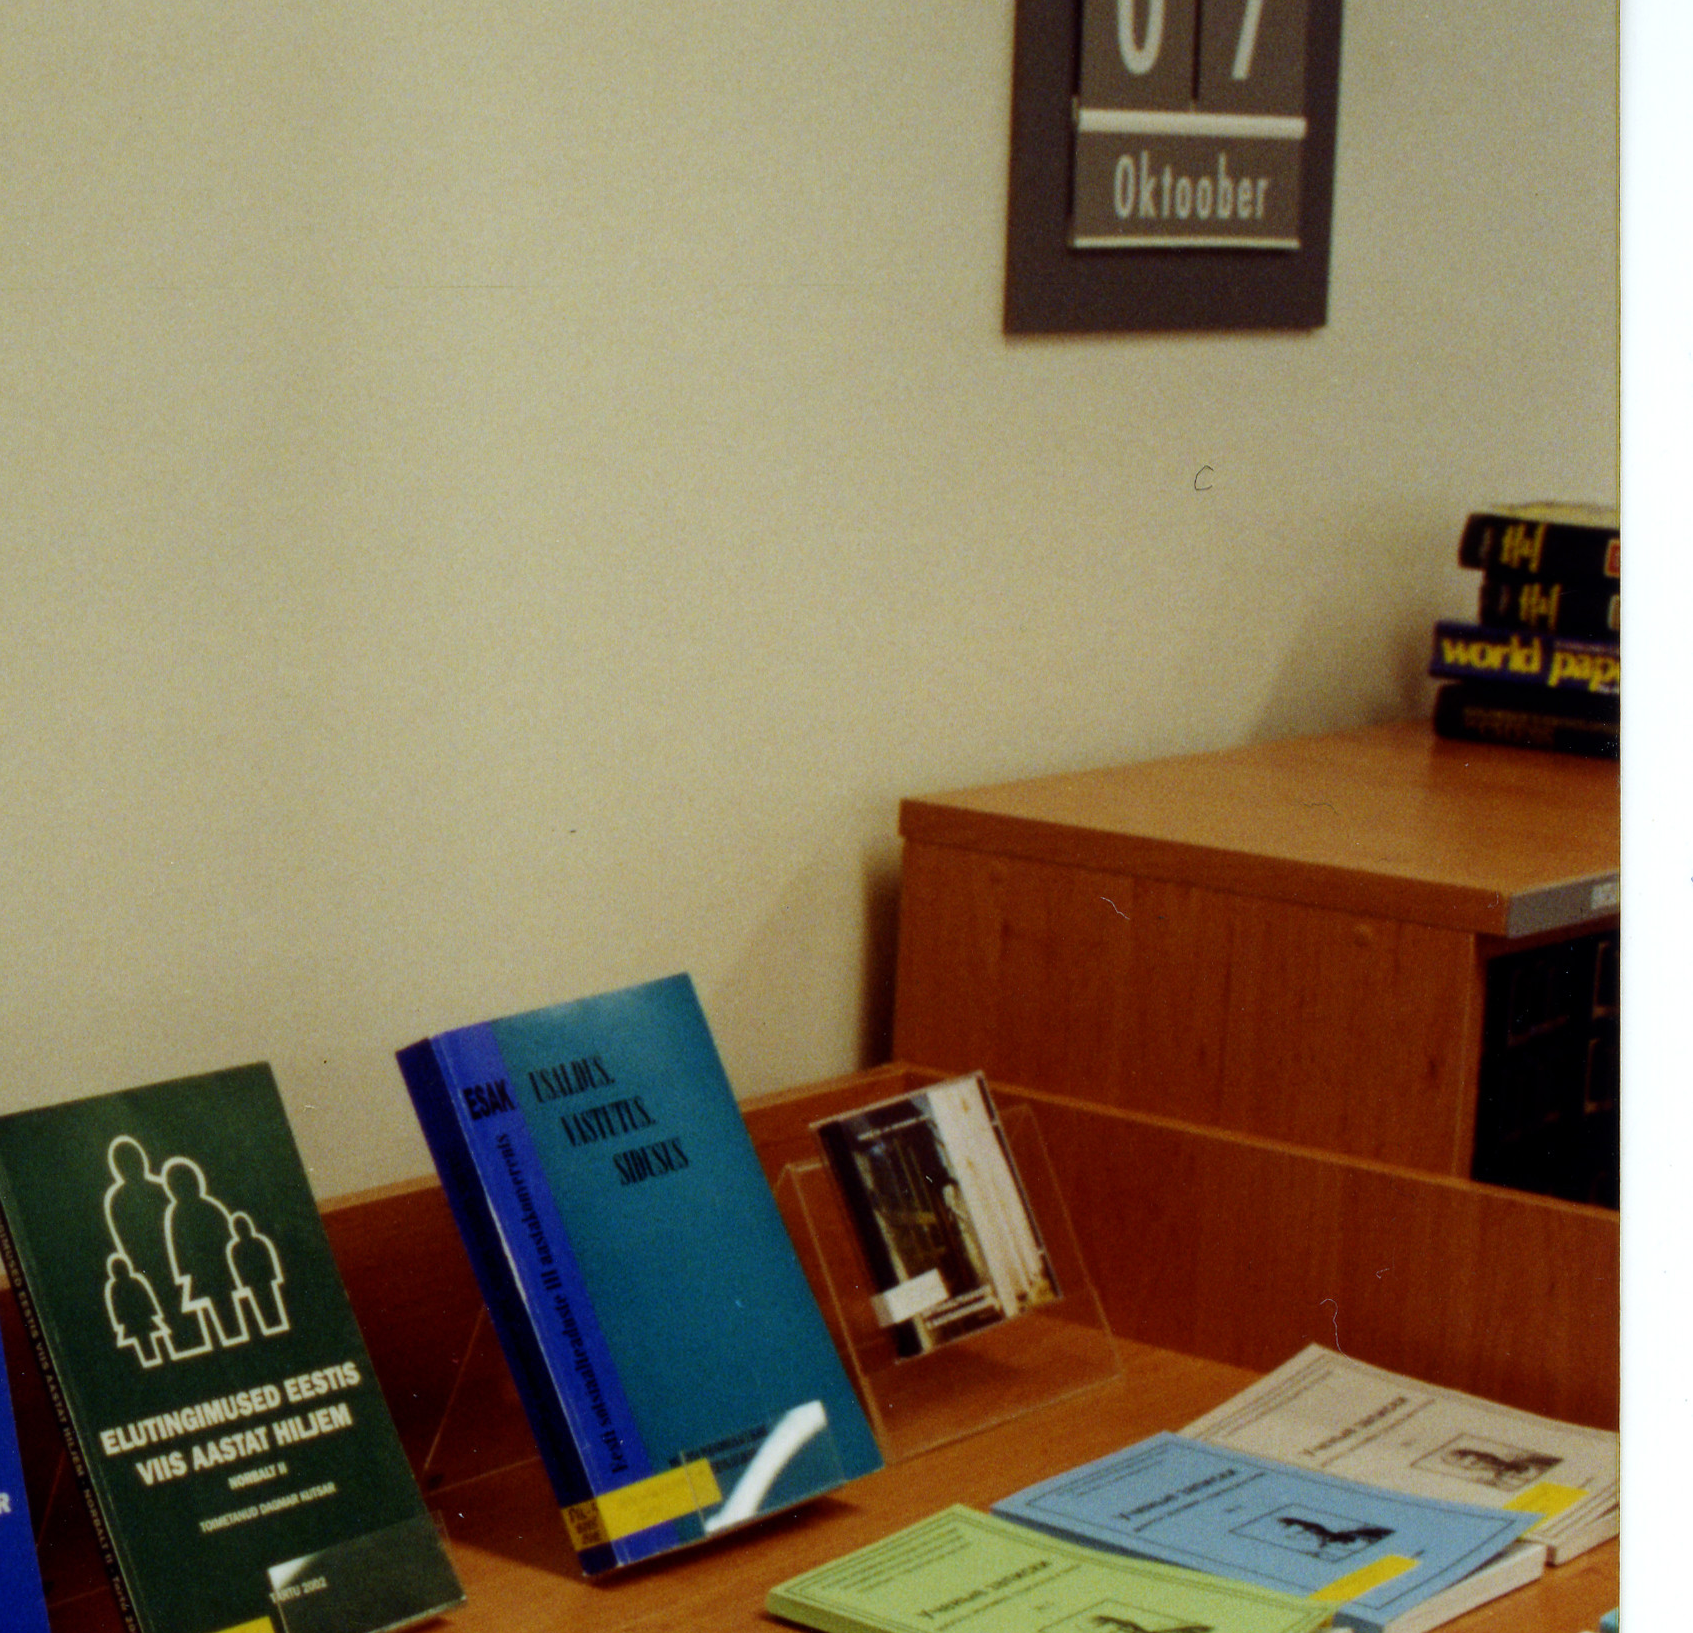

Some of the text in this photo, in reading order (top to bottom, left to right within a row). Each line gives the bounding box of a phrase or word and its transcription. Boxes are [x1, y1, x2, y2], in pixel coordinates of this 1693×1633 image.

[1113, 152, 1270, 224] Oktoober
[1442, 633, 1543, 675] world
[463, 1077, 516, 1122] ESAK
[99, 1360, 362, 1457] ELUTINGIMUSED EESTIS
[135, 1401, 354, 1487] VIIS AASTAT HILJEM
[299, 1480, 338, 1504] KUTSAR
